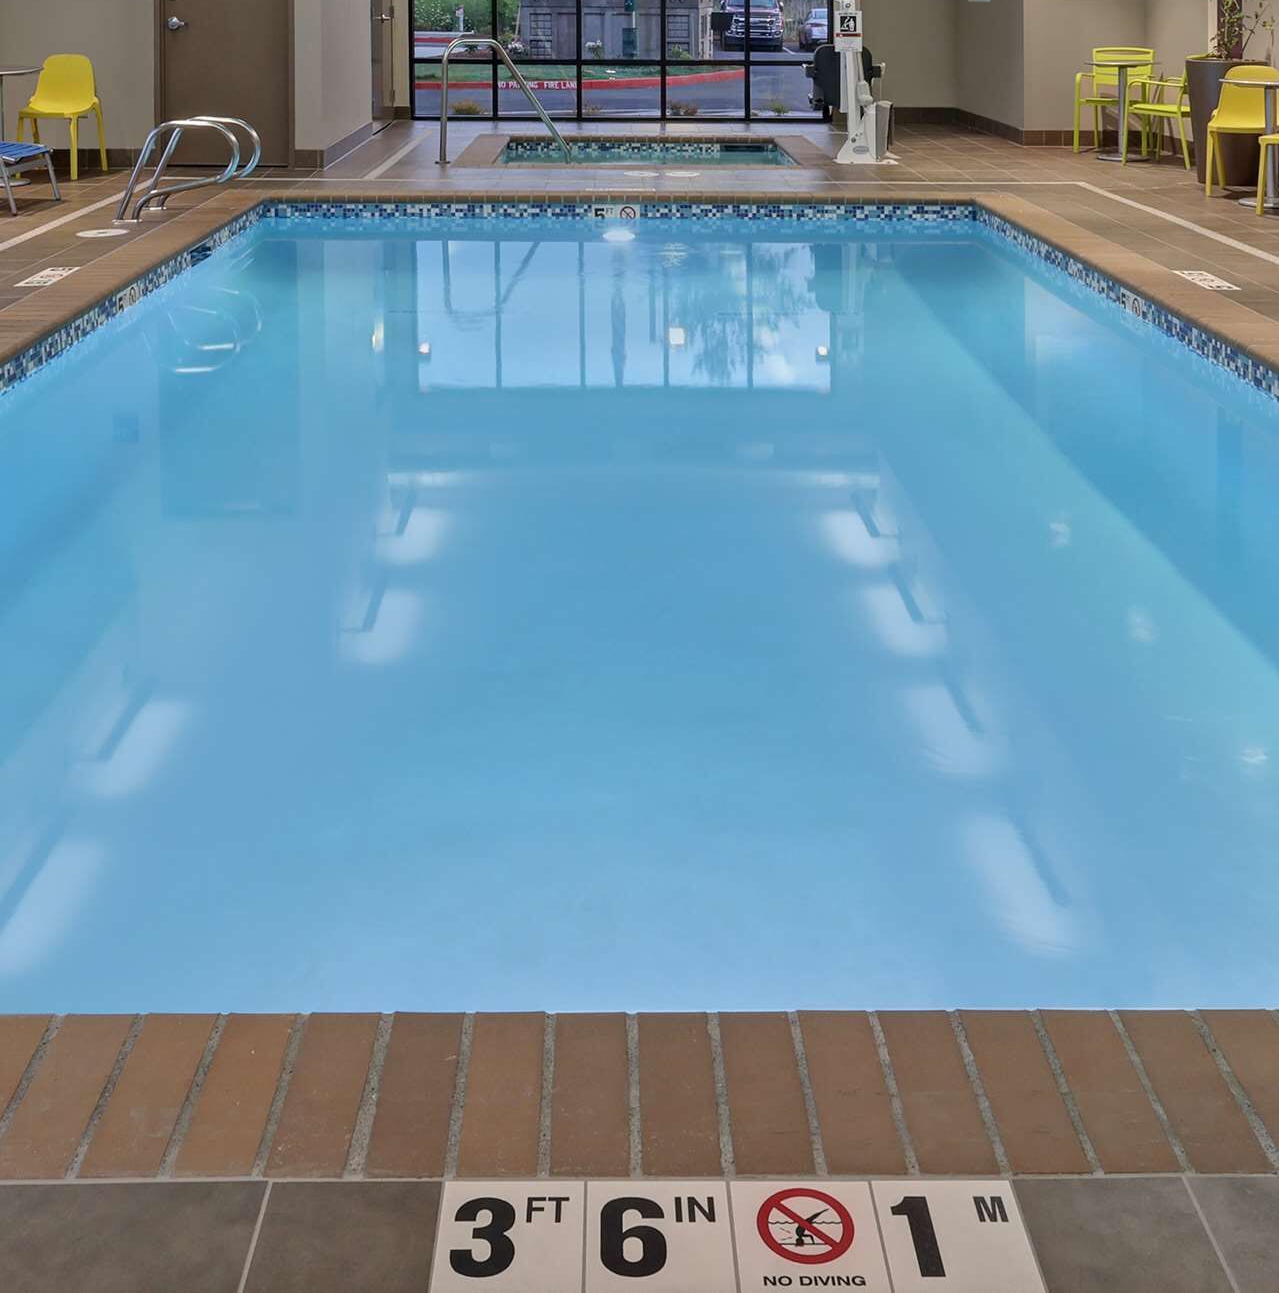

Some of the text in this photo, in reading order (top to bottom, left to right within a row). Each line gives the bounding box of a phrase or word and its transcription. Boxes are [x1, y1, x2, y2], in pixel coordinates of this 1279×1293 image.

[560, 81, 578, 90] LAN
[449, 1196, 1009, 1278] 3 FT 6 IN 1 M
[763, 1276, 866, 1286] NO DIVING
